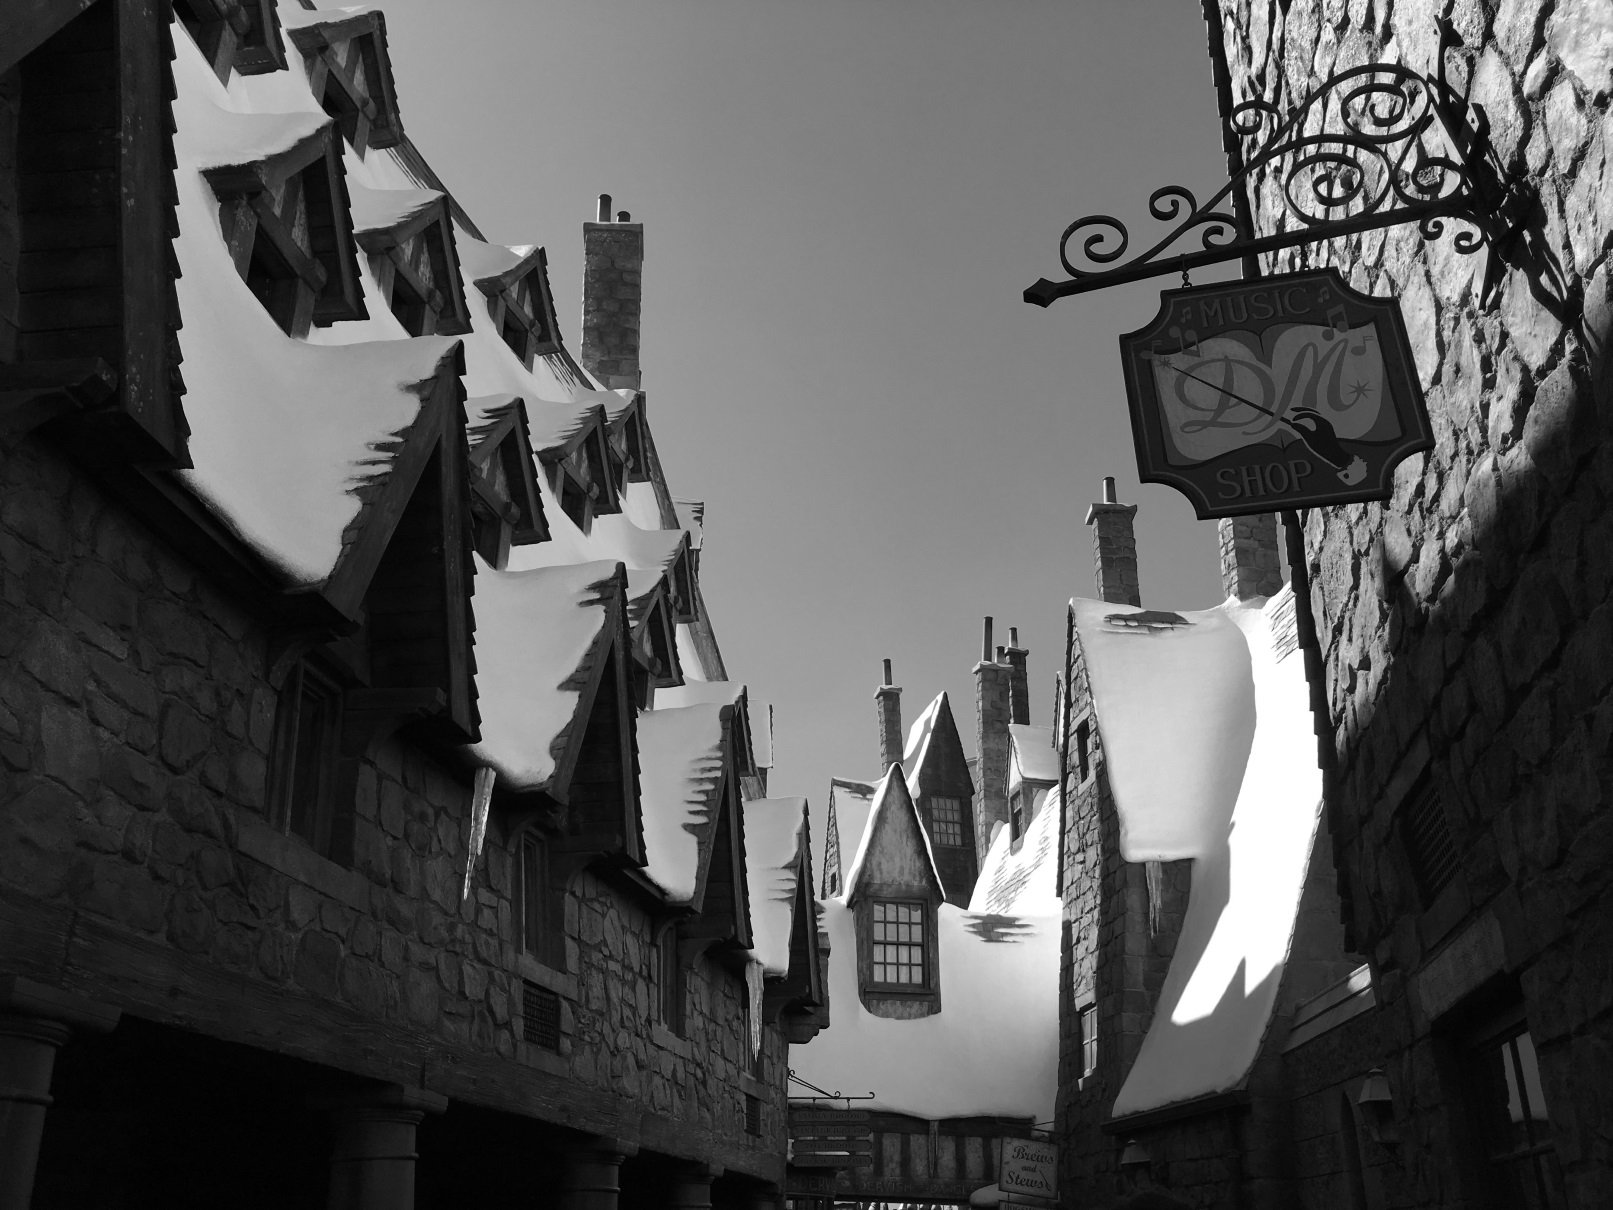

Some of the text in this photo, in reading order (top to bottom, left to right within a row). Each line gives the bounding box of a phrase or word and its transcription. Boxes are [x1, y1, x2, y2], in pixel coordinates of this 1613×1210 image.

[1199, 286, 1311, 329] MUSIC
[1215, 459, 1312, 500] SHOP
[1012, 1144, 1055, 1165] Brews
[1021, 1164, 1038, 1173] and
[1005, 1170, 1044, 1189] Stews
